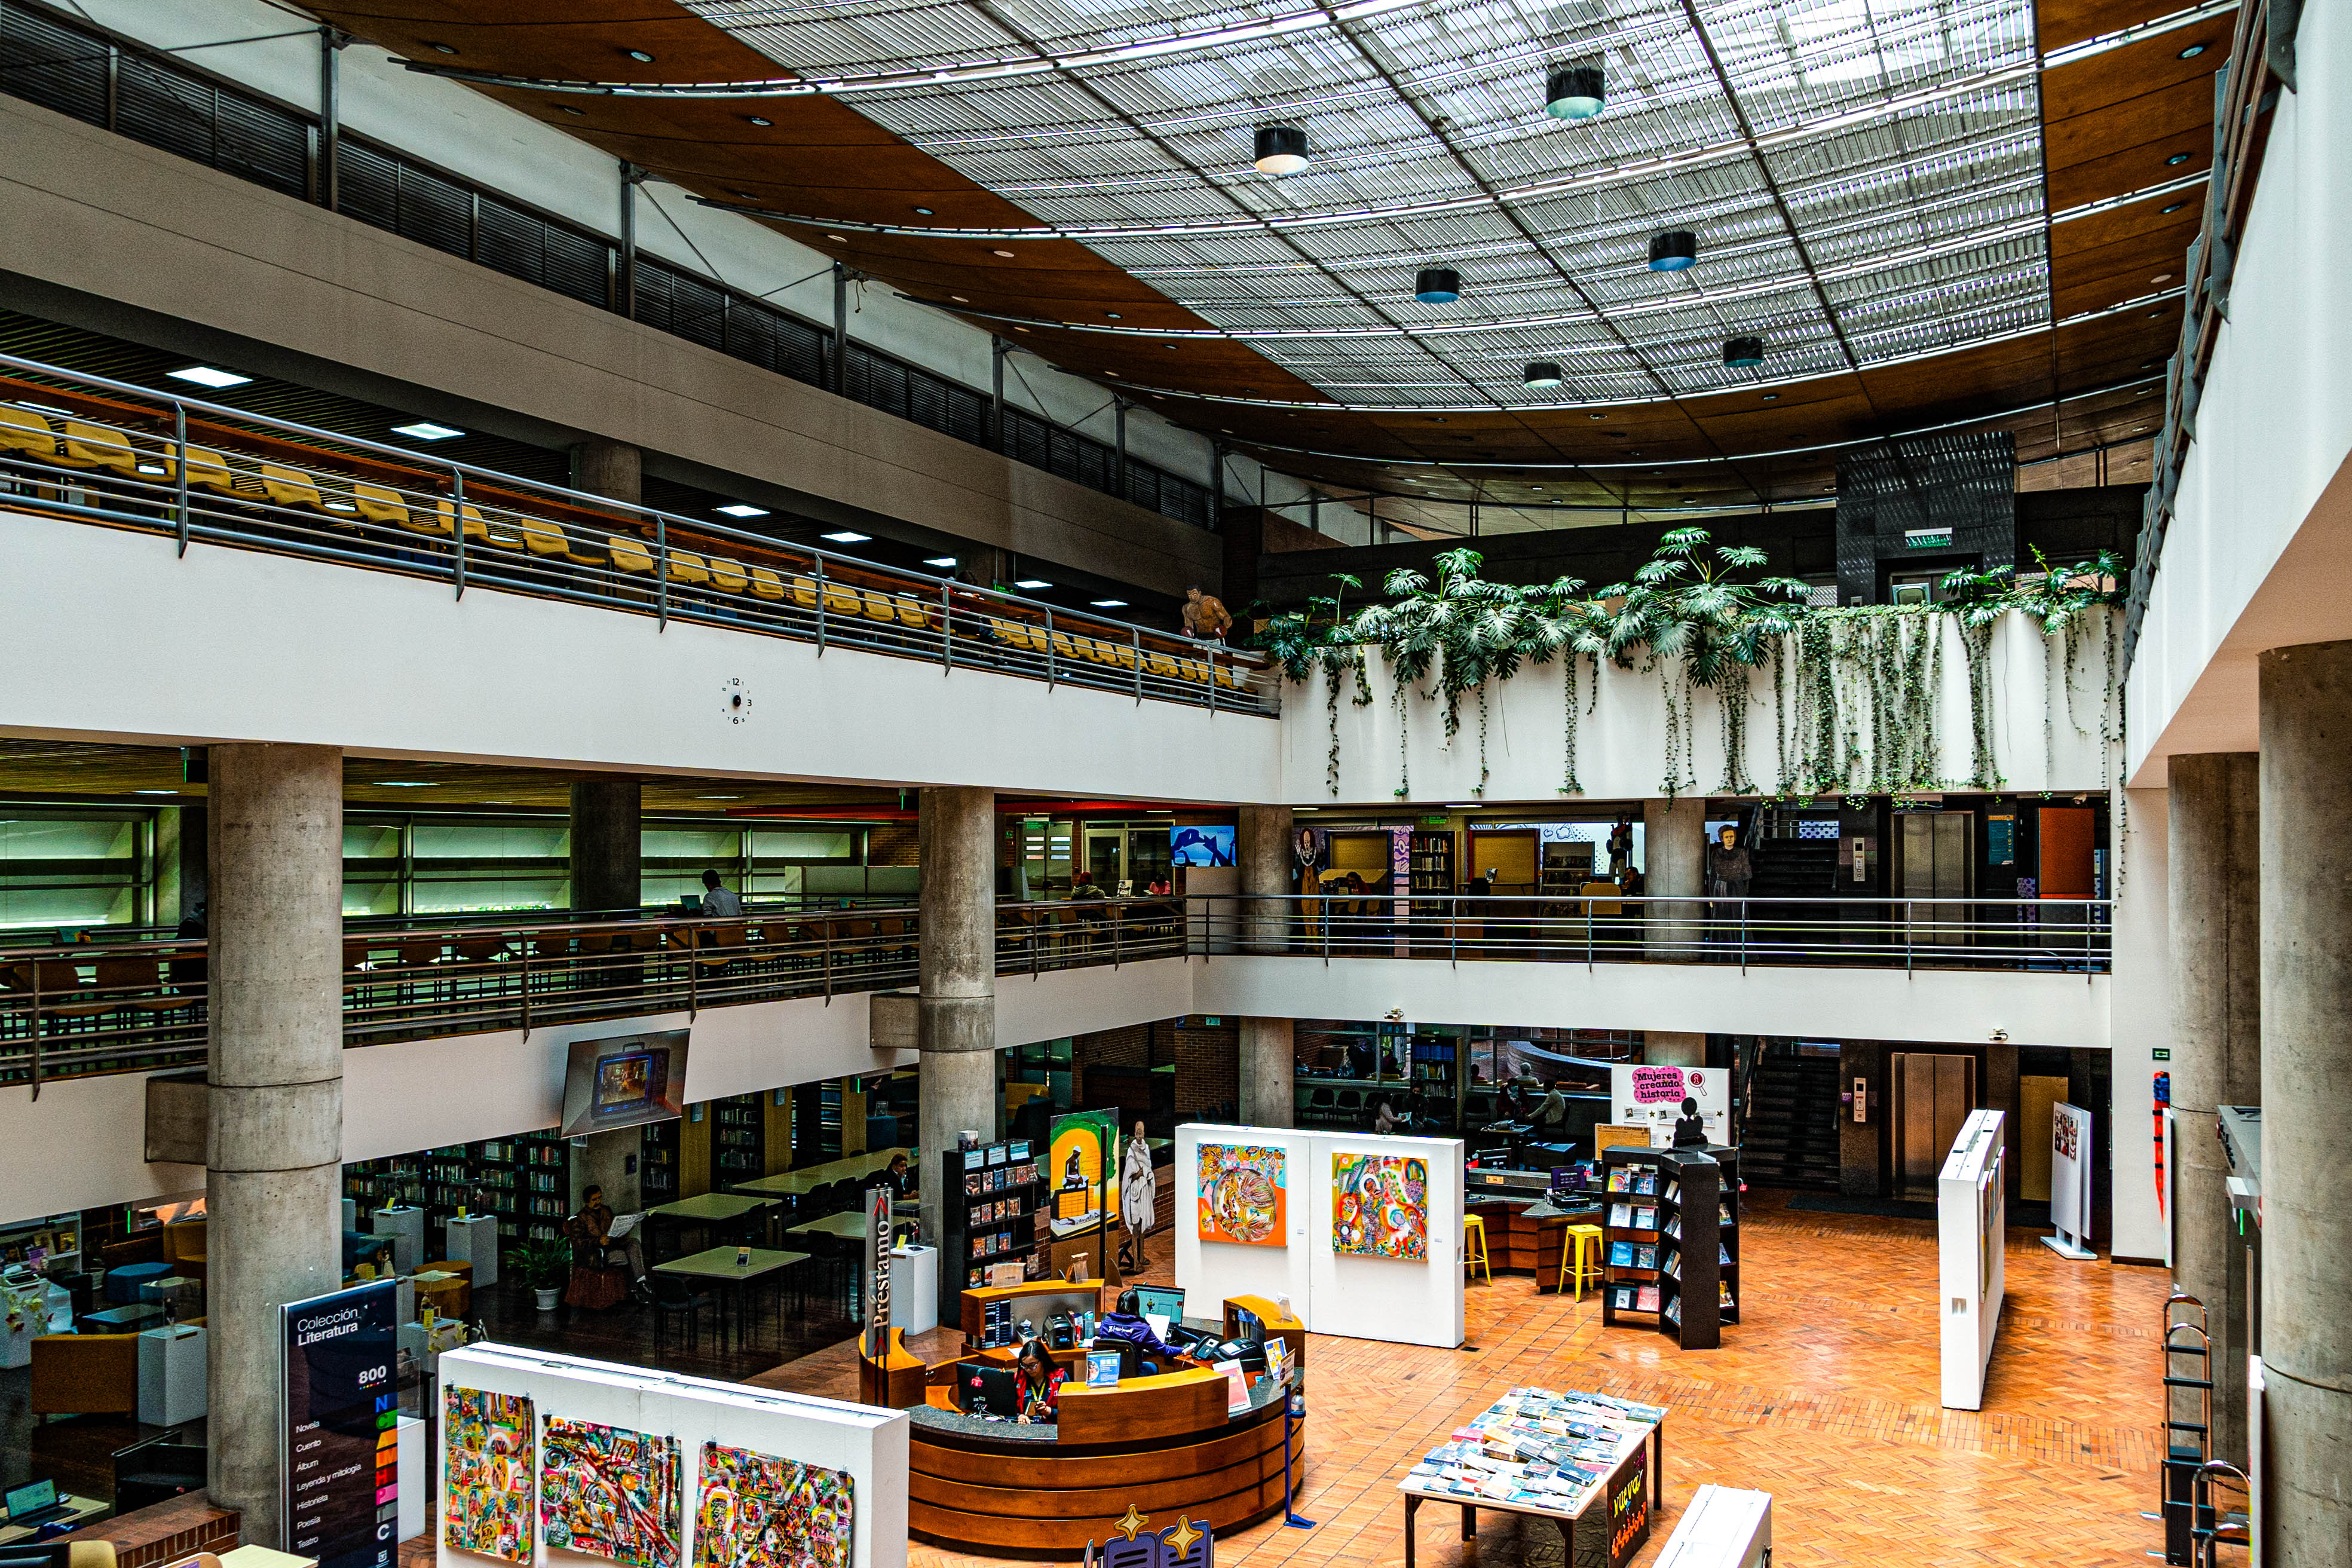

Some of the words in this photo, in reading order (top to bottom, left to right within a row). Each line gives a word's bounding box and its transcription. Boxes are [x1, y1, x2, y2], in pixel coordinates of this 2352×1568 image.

[732, 678, 740, 686] 12
[1637, 1071, 1677, 1082] Mujeres
[1640, 1080, 1680, 1089] creando
[1640, 1089, 1681, 1098] historia
[871, 1220, 890, 1330] Préstamo
[298, 1308, 358, 1332] Colección
[298, 1322, 359, 1346] Literatura
[359, 1365, 387, 1384] 800
[375, 1394, 388, 1413] N
[296, 1420, 321, 1434] Novela
[376, 1413, 388, 1430] C
[296, 1440, 322, 1453] Cuento
[296, 1459, 319, 1472] Álbum
[296, 1476, 326, 1492] Leyenda
[326, 1474, 332, 1483] y
[332, 1463, 362, 1479] mitología
[376, 1469, 388, 1487] H
[296, 1494, 329, 1511] Historieta
[376, 1488, 386, 1506] P
[296, 1515, 321, 1530] Poesía
[376, 1505, 386, 1523] T
[376, 1524, 390, 1541] C
[297, 1536, 319, 1549] Teatro
